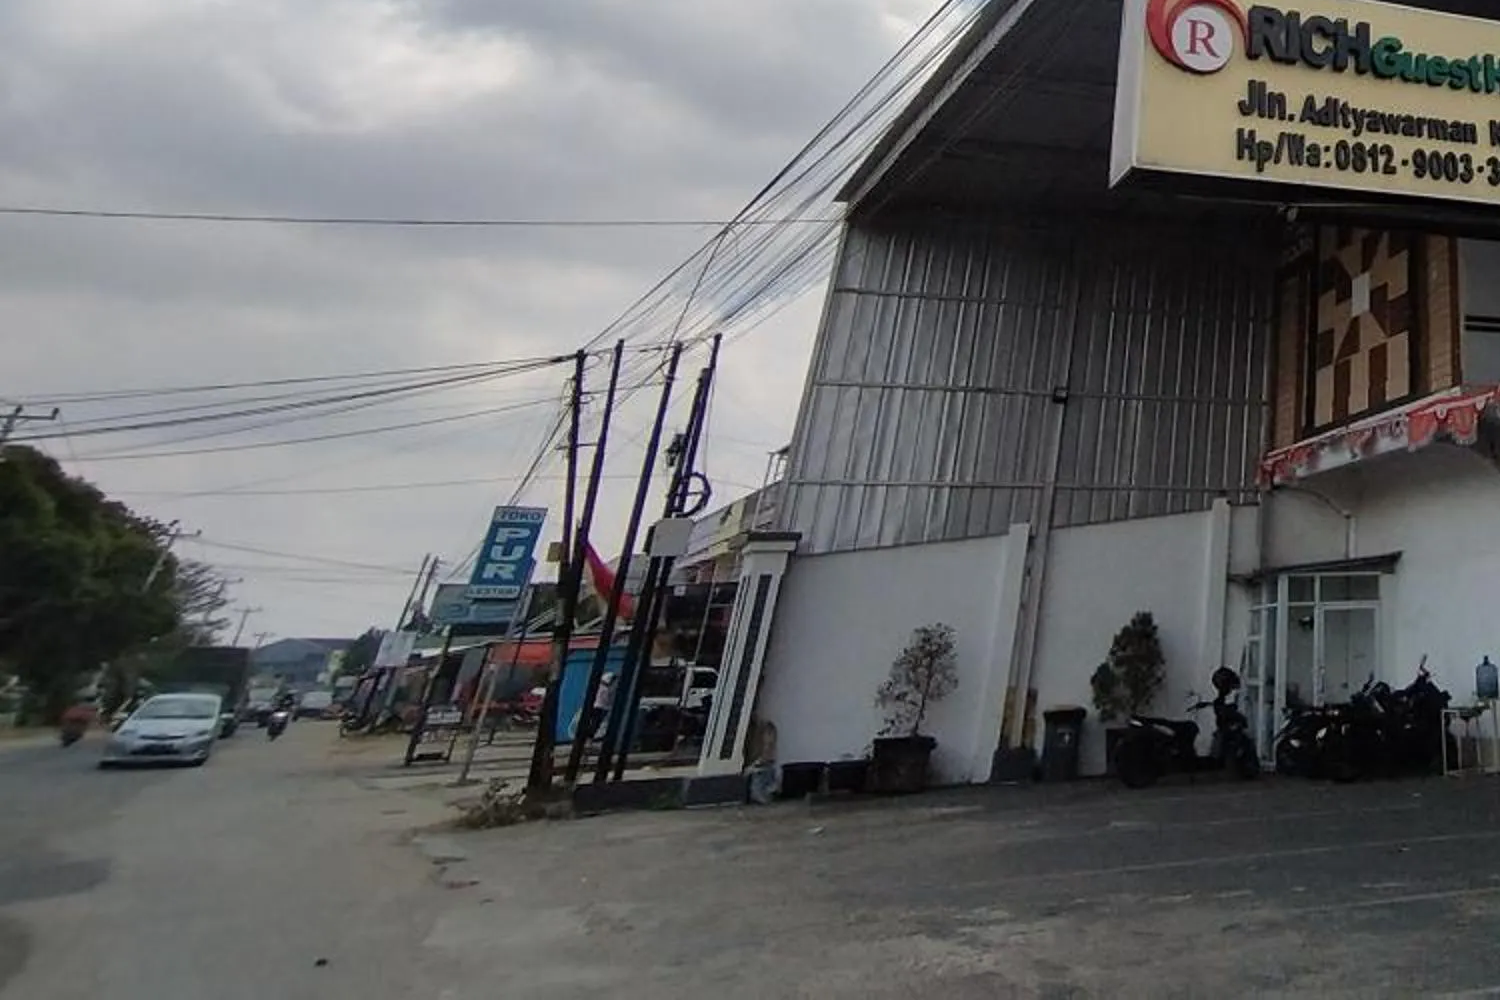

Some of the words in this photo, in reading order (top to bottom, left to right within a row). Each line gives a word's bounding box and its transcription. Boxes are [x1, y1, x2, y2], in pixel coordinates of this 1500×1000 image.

[1185, 19, 1220, 60] R
[1299, 93, 1478, 145] Adityawarman
[500, 510, 542, 521] TOKO
